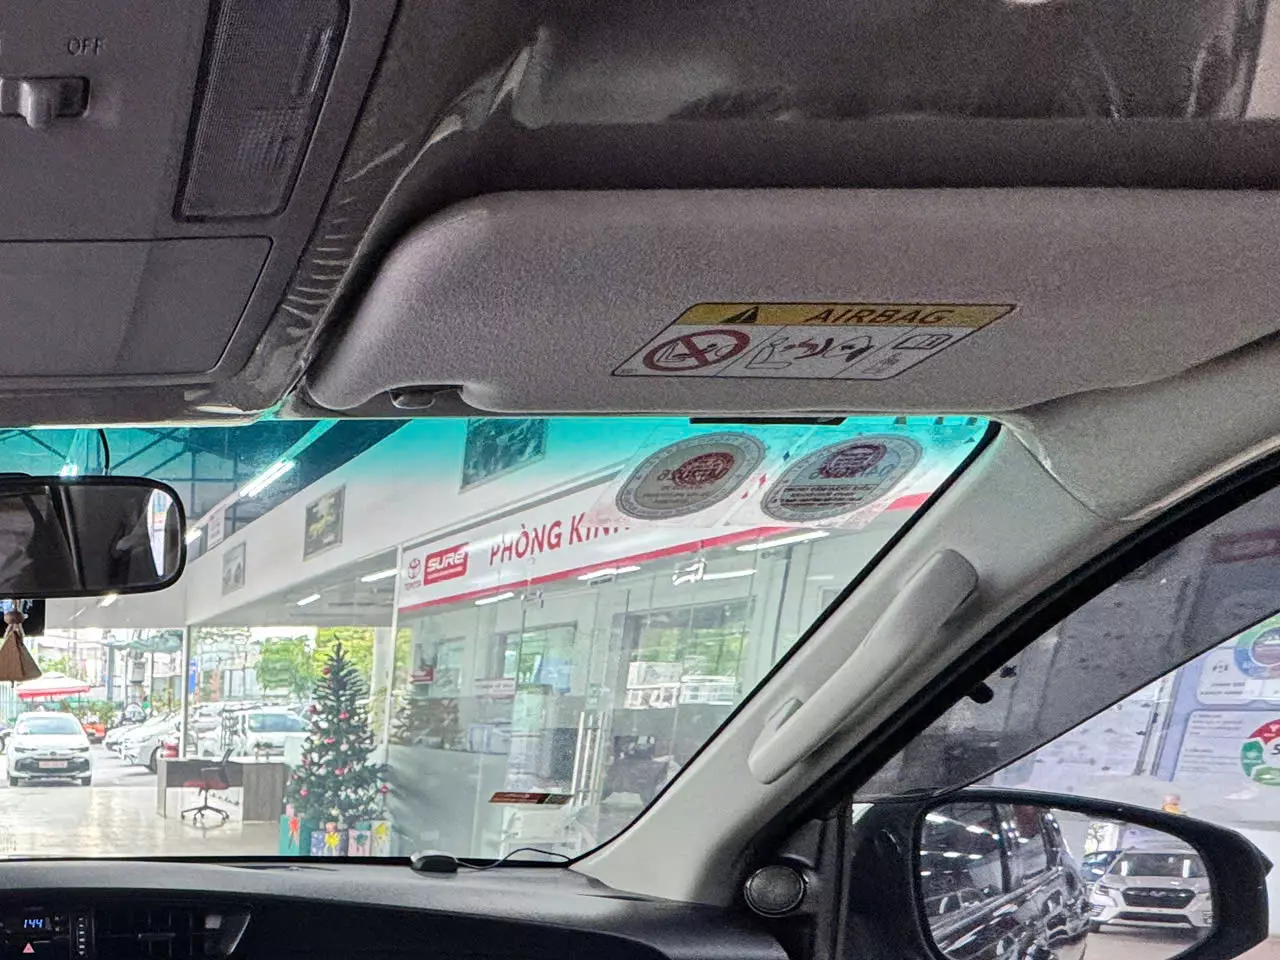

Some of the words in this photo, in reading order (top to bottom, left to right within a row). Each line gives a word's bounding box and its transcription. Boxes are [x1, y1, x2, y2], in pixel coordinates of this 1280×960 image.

[68, 36, 108, 56] OFF
[802, 308, 956, 324] AIRBAG
[489, 519, 563, 566] PHÒNG
[427, 550, 466, 573] SURE
